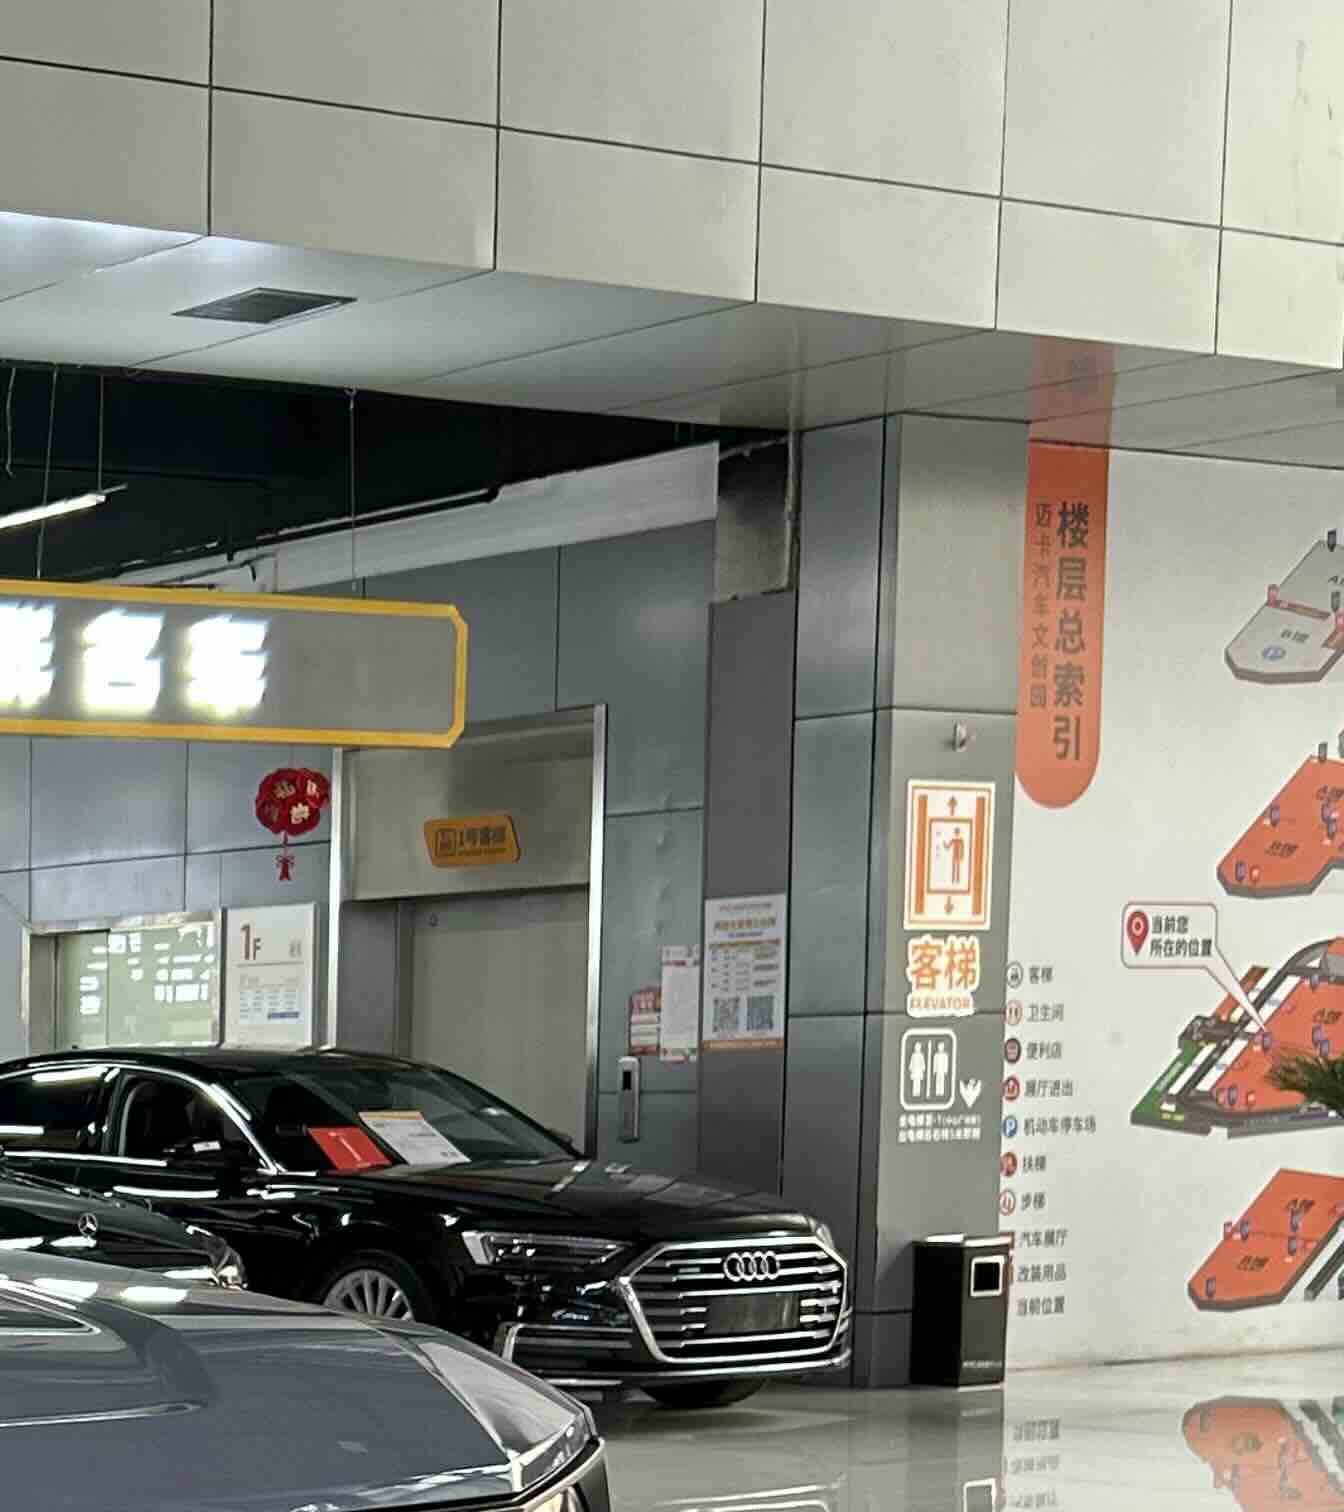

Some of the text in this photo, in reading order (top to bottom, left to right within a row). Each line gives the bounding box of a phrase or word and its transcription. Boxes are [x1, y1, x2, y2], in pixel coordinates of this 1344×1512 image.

[1052, 500, 1089, 761] 楼层总索引
[1151, 915, 1189, 934] 当前您
[1150, 938, 1213, 958] 所在的位置
[909, 940, 979, 990] 客梯
[1026, 1003, 1064, 1023] 卫生间
[1026, 1042, 1062, 1060] 便利店
[1023, 1115, 1096, 1136] 机动车停车场
[1020, 1228, 1068, 1248] 汽车展厅
[1017, 1263, 1067, 1282] 改装用品
